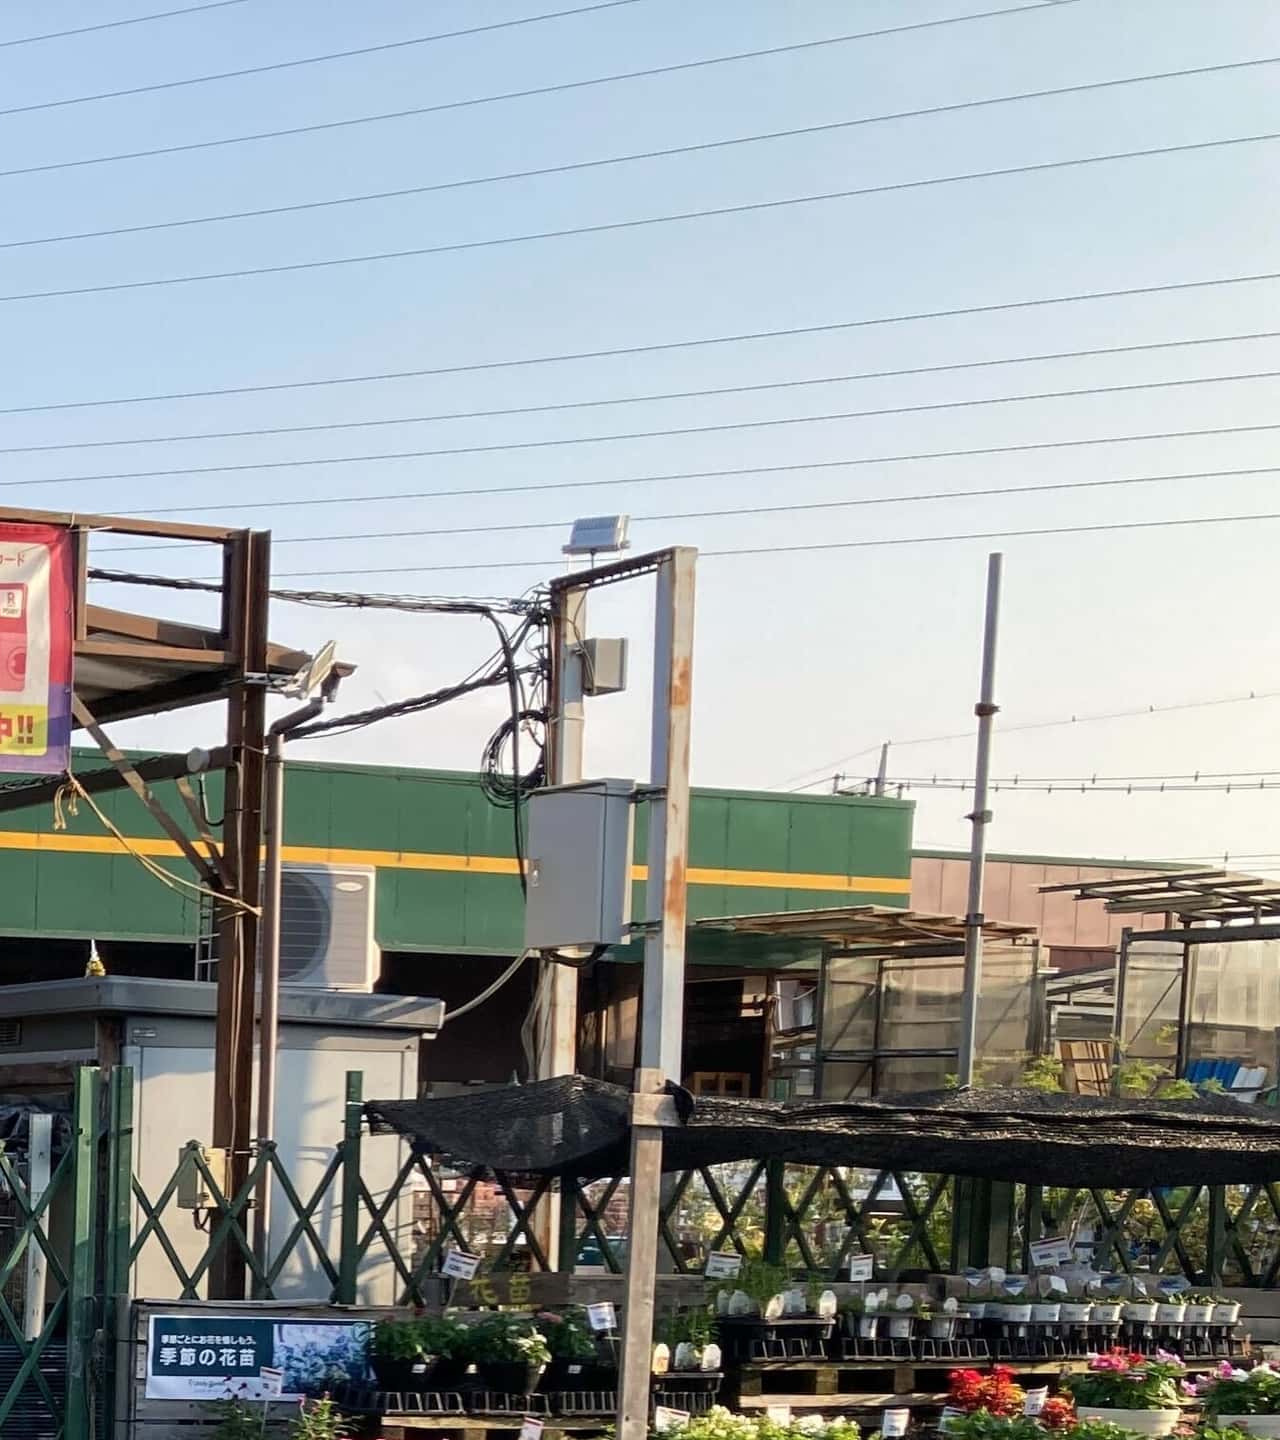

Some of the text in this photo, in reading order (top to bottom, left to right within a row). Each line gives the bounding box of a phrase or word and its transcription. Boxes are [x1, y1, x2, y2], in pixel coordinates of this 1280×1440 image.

[159, 1348, 256, 1367] 季節の花苗
